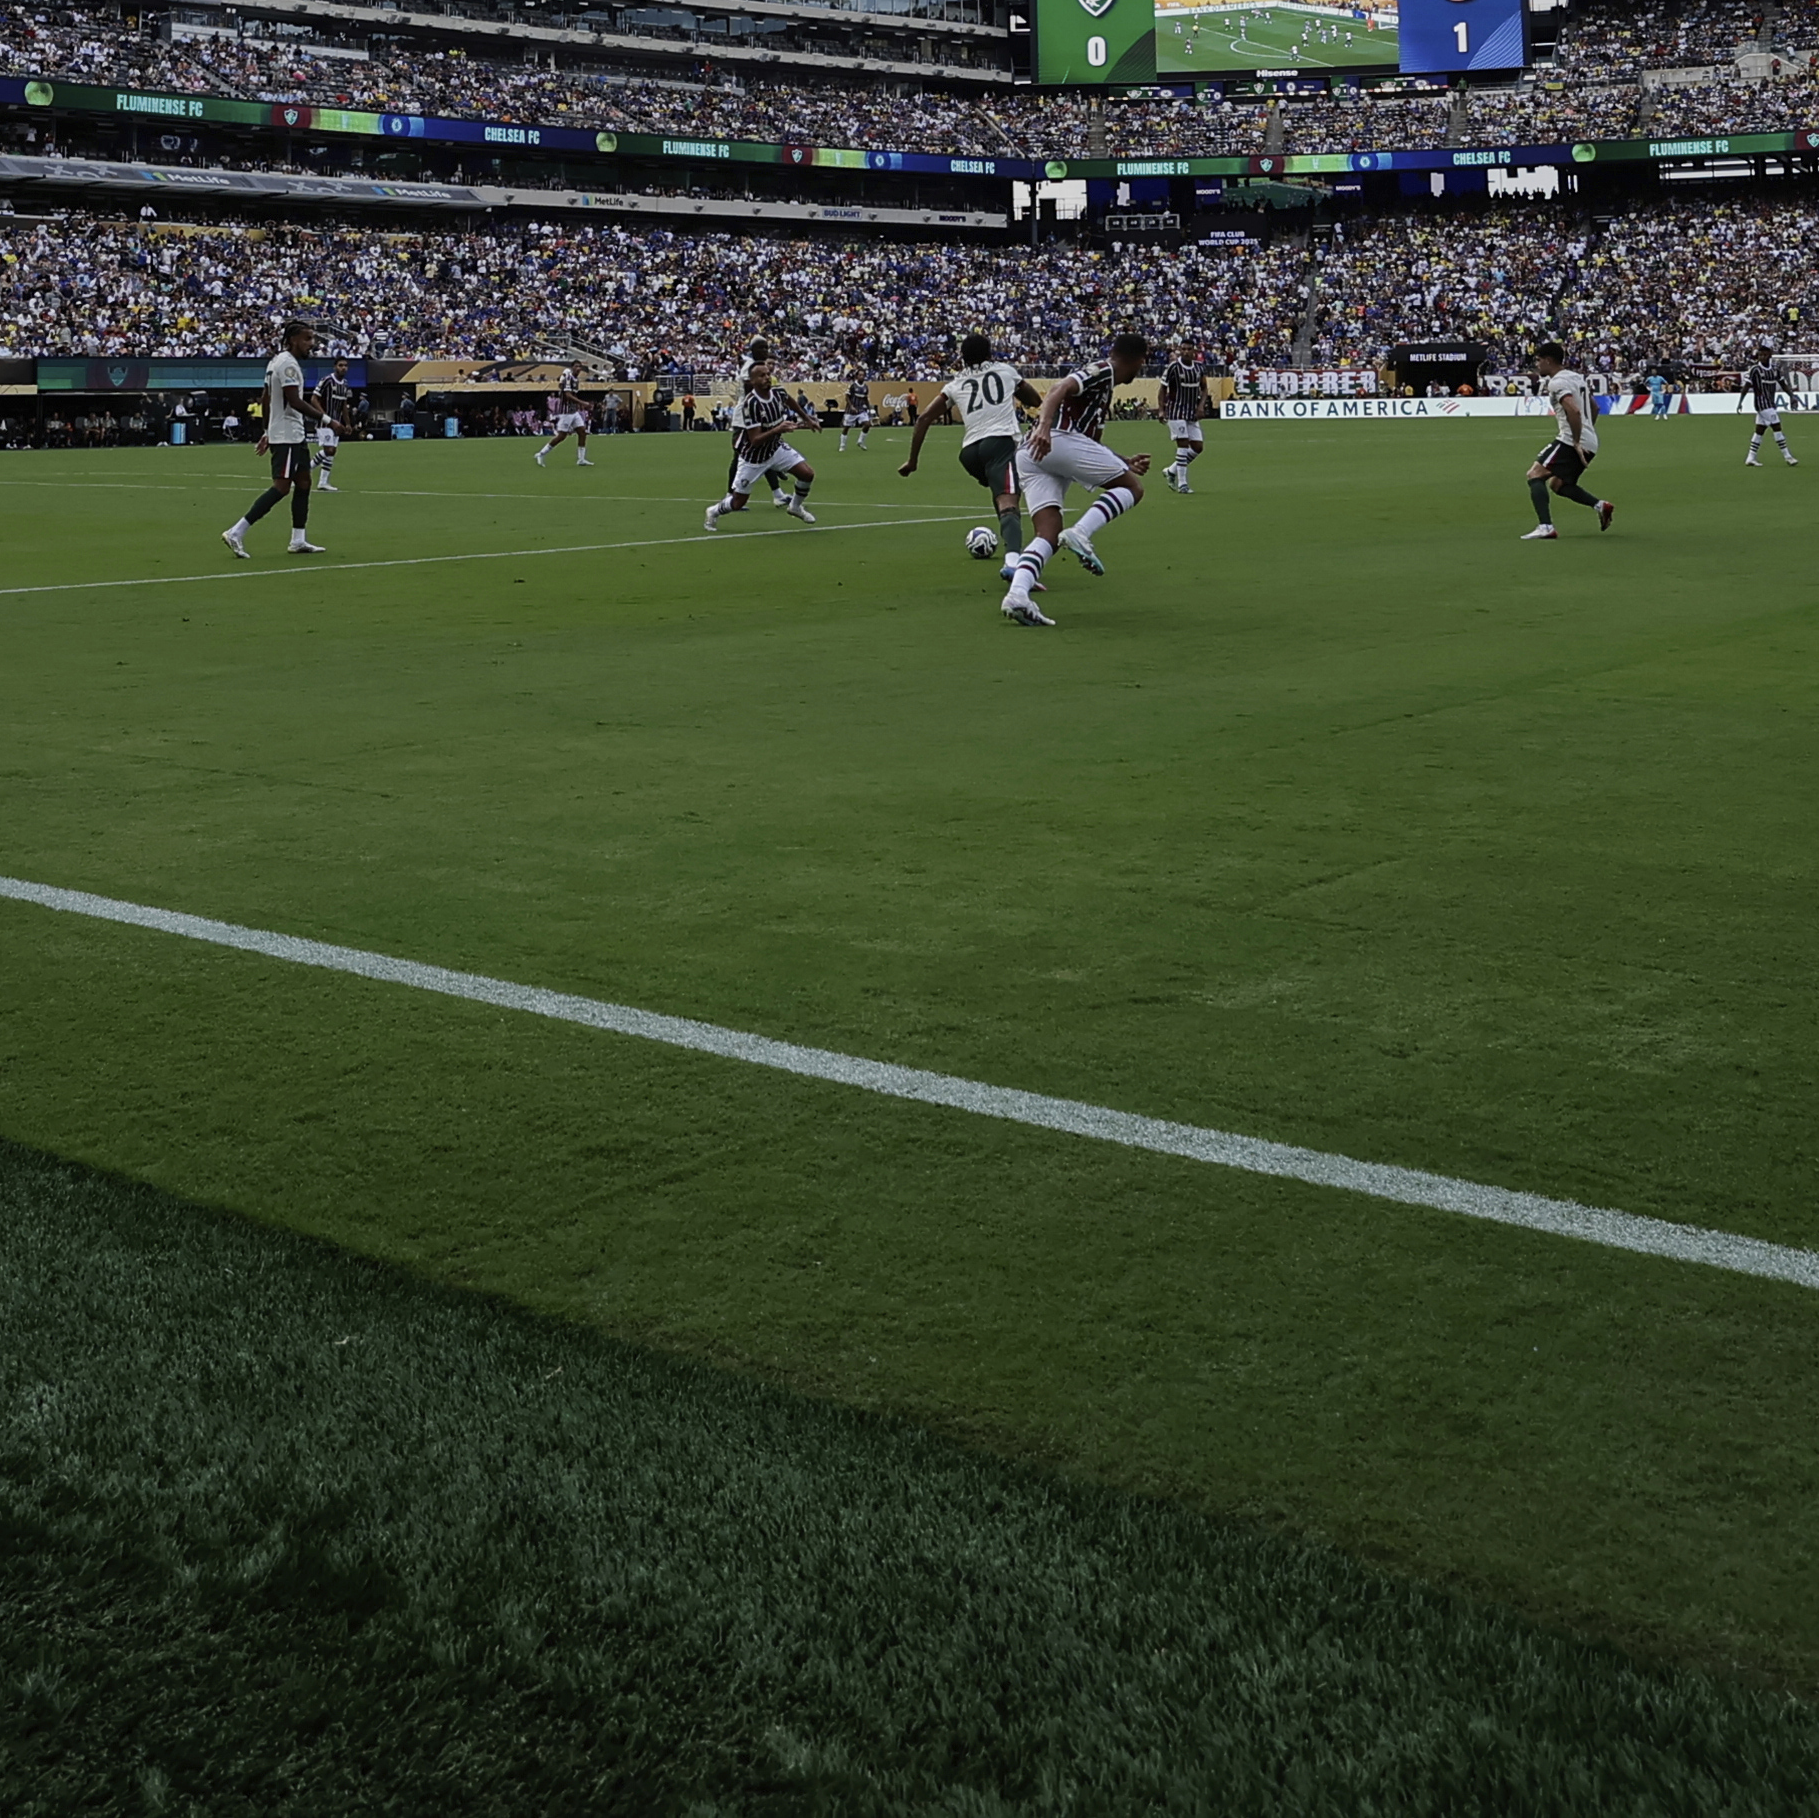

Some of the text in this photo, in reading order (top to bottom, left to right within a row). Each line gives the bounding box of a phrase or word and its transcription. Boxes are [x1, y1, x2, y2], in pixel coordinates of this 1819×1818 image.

[1453, 21, 1468, 53] 1
[1087, 35, 1106, 66] 0
[1256, 68, 1299, 78] Hisense
[116, 93, 203, 117] FLUMINENSE FC
[484, 126, 540, 145] CHELSEA FC
[662, 140, 730, 158] FLUMINENSE FC
[1649, 139, 1729, 157] FLUMINENSE FC
[1453, 150, 1511, 165] CHELSEA FC
[951, 160, 996, 174] CHELSEA FC
[1117, 161, 1189, 176] FLUMINENSE FC
[167, 173, 230, 185] MetLife
[394, 188, 452, 199] MetLife
[594, 196, 624, 206] MetLife
[1210, 230, 1245, 238] FIFA CLUB
[1198, 238, 1224, 246] WORLD
[1409, 352, 1467, 362] METLIFE STADIUM
[960, 370, 1005, 415] 20
[1225, 399, 1429, 417] BANK OF AMERICA
